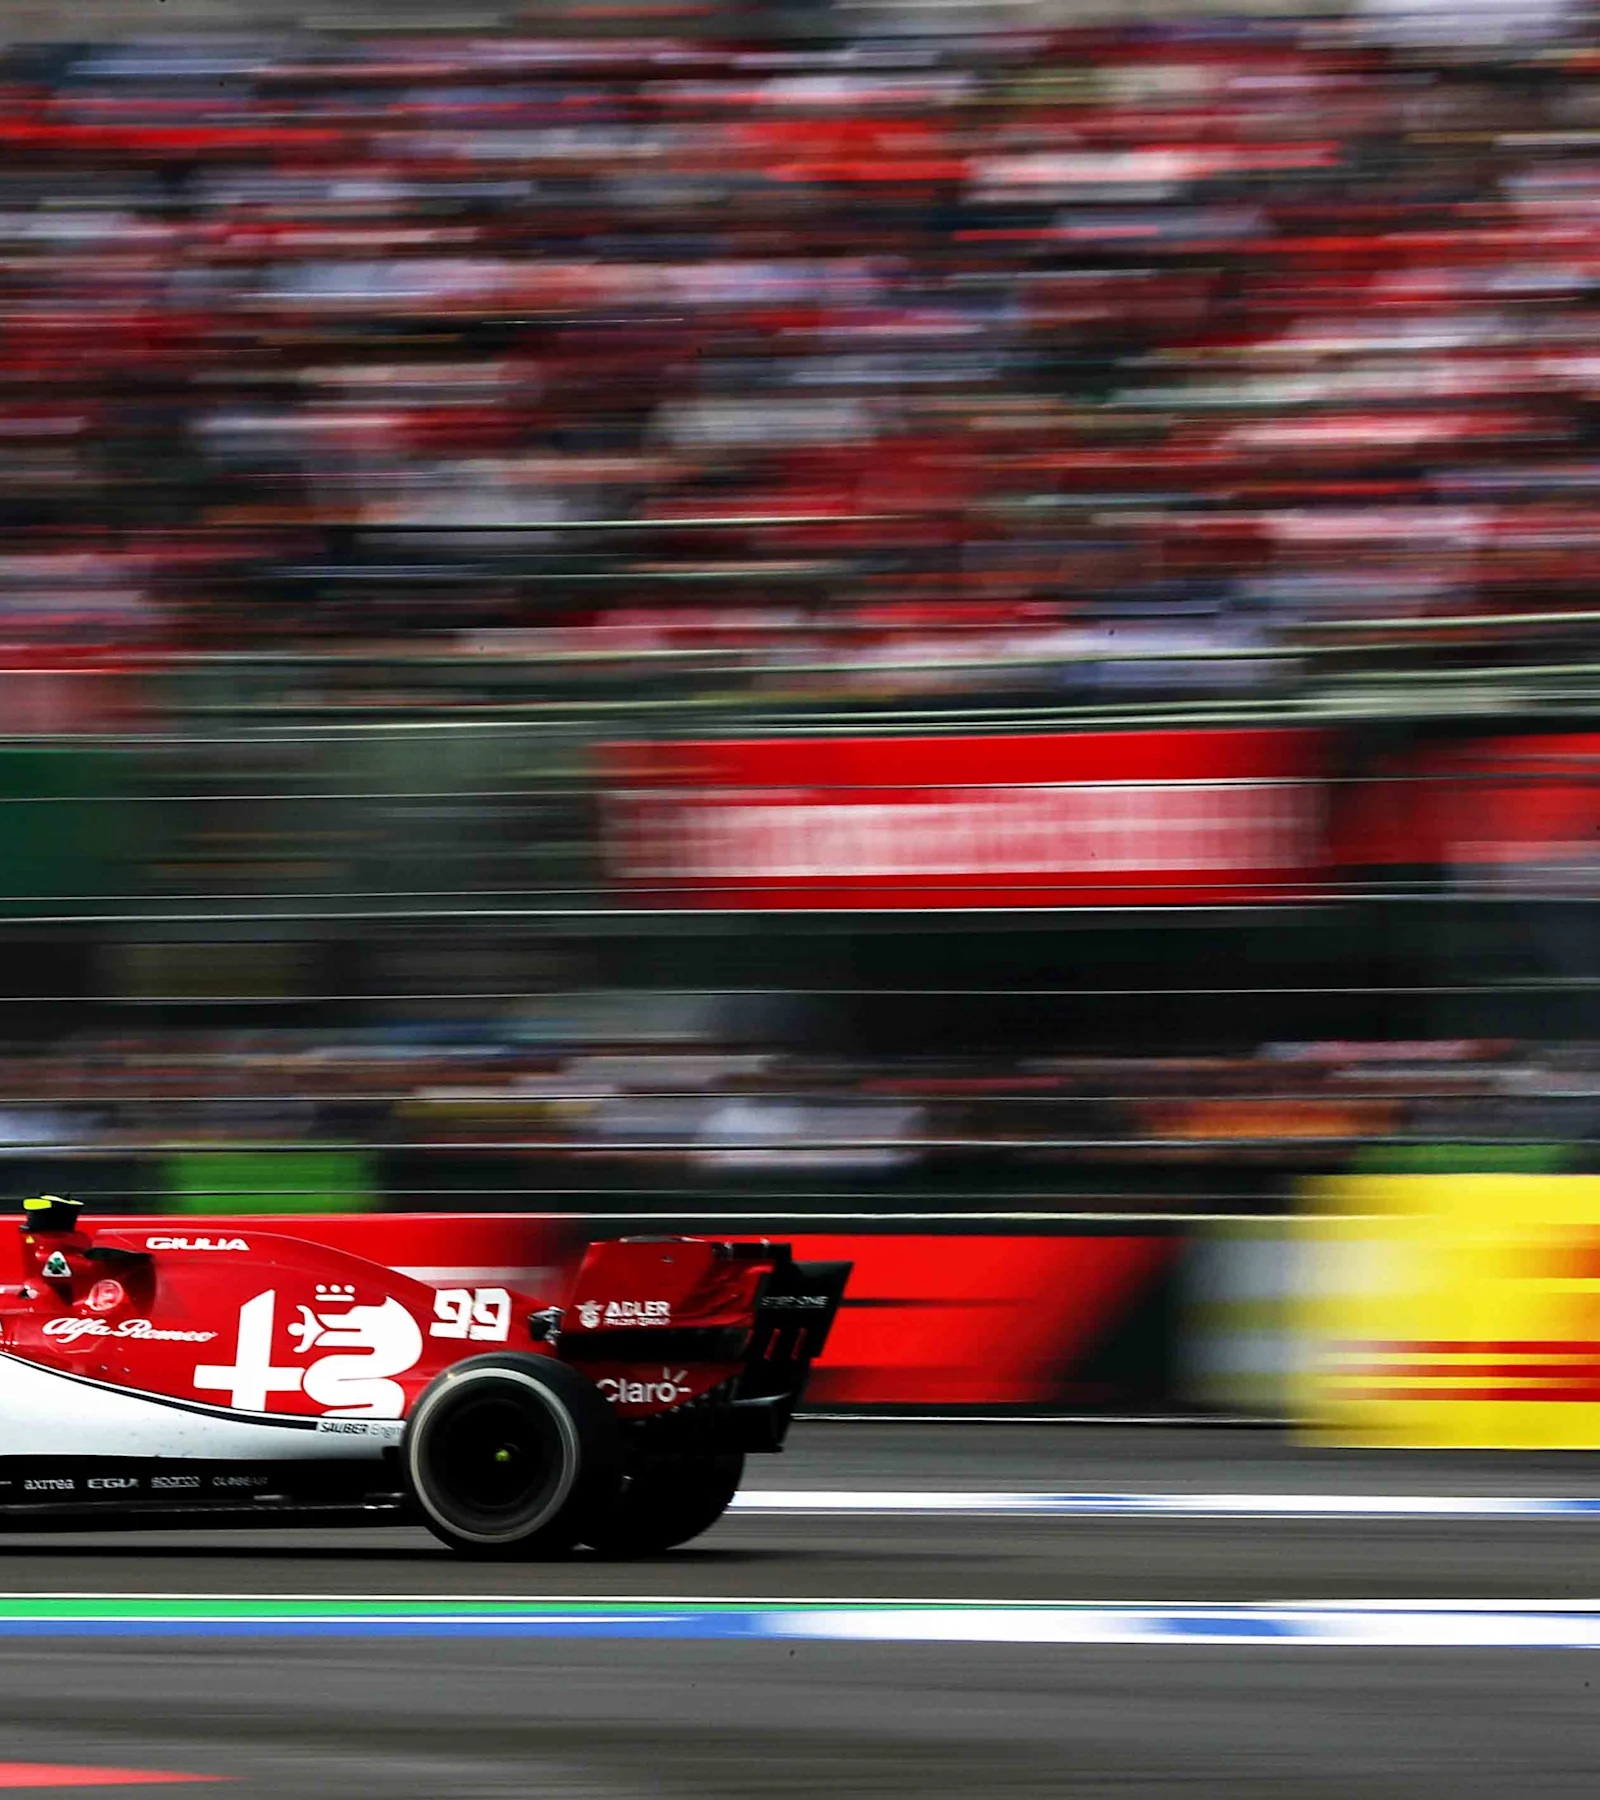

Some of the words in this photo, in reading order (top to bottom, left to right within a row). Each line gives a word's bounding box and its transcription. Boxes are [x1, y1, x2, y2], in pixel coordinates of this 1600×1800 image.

[146, 1237, 250, 1251] GIULIA
[429, 1287, 512, 1341] 99
[604, 1301, 671, 1317] ADLER
[42, 1318, 110, 1343] Alfa
[109, 1319, 218, 1342] Romeo
[597, 1378, 677, 1403] Claro
[320, 1422, 368, 1434] SAUBER
